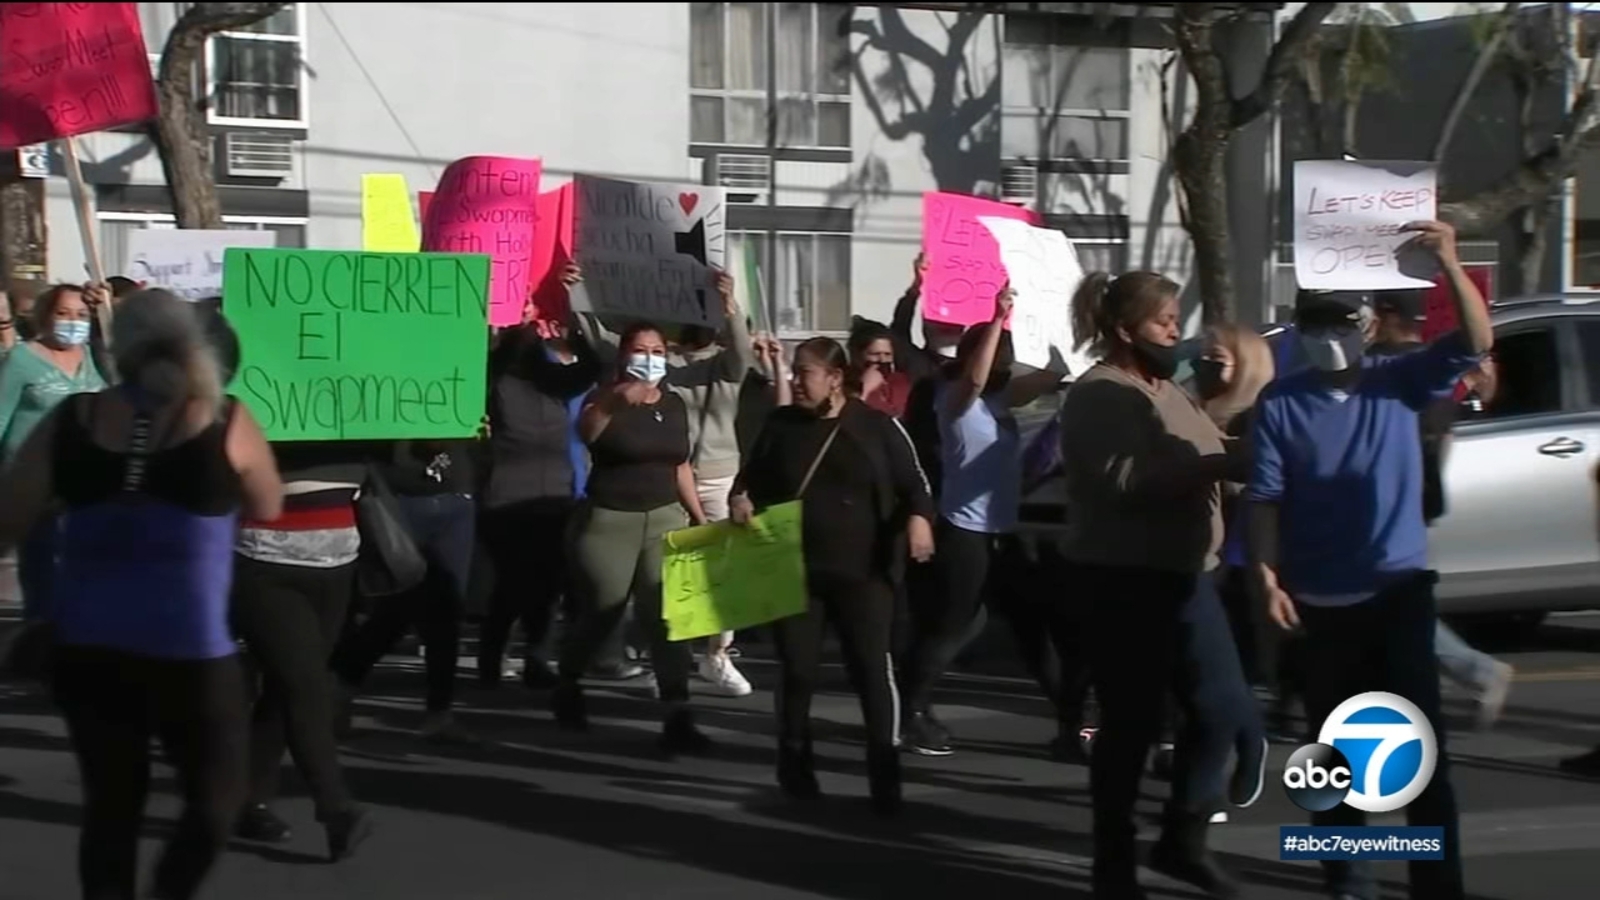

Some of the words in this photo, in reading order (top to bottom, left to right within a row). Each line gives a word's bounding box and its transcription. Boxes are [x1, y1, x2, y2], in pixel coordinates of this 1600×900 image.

[1308, 187, 1374, 215] LET'S
[1378, 187, 1432, 212] KEEP
[244, 251, 314, 308] NO
[321, 253, 487, 319] CIERREN
[242, 365, 472, 440] Swapmeet
